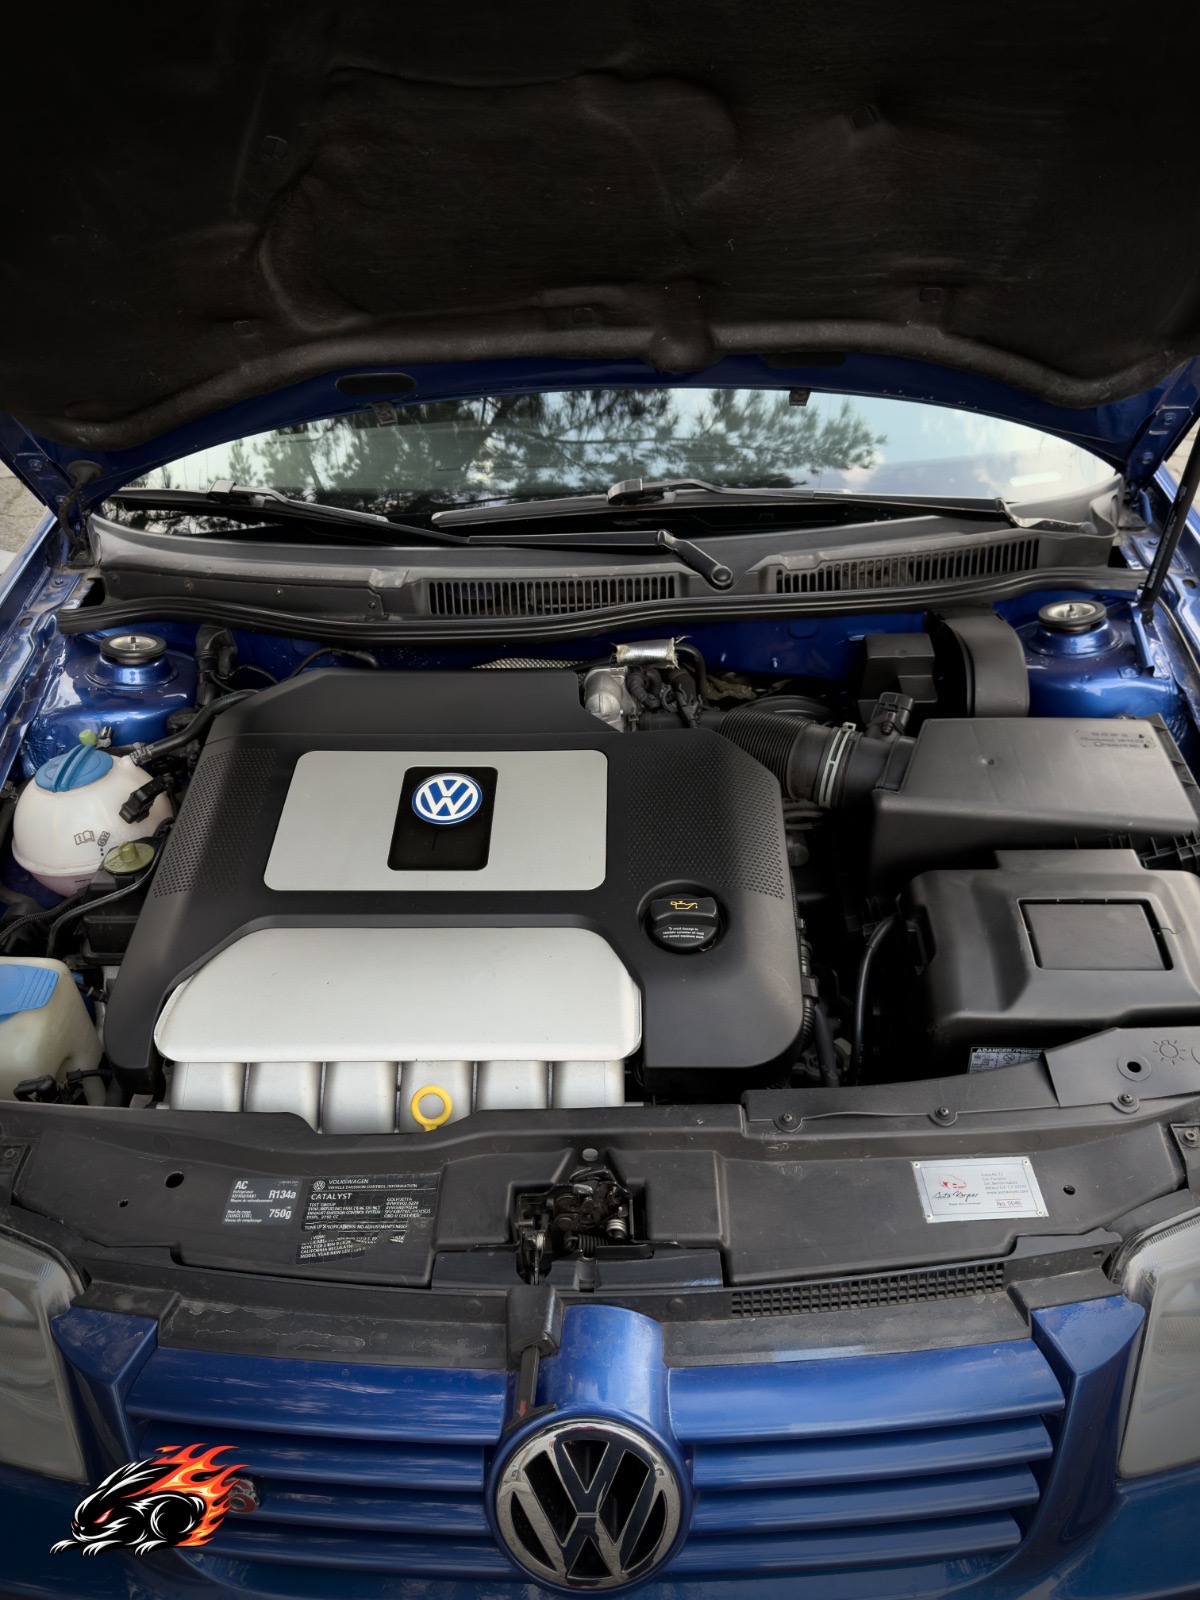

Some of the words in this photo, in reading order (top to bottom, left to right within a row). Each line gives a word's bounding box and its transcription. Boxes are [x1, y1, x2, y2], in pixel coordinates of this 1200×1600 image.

[234, 1180, 248, 1190] AC
[268, 1190, 296, 1199] R134a
[932, 1192, 951, 1200] Auto
[269, 1208, 292, 1220] 750g
